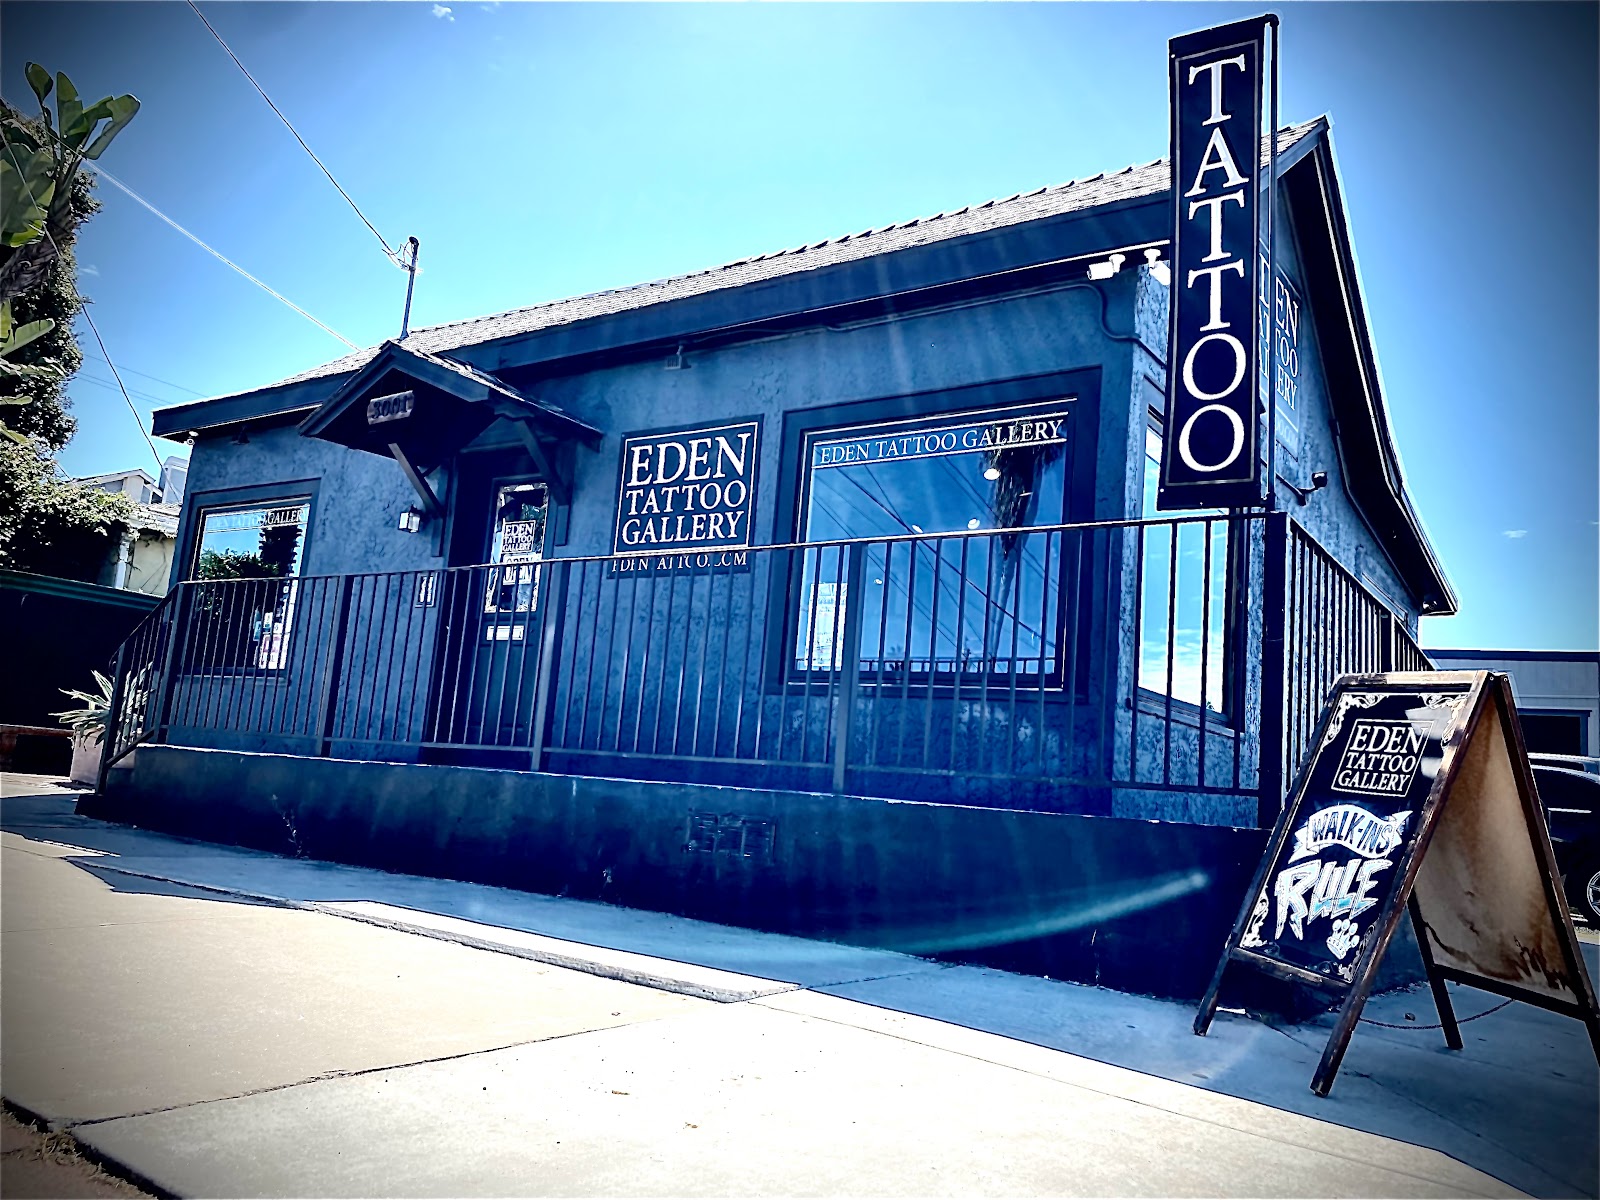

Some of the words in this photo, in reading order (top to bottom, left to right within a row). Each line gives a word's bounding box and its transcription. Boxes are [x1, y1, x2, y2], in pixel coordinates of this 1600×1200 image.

[1179, 54, 1249, 473] TATTOO
[820, 442, 871, 465] EDEN
[875, 432, 956, 460] TATTOO
[962, 418, 1064, 449] GALLERY
[626, 433, 751, 487] EDEN
[625, 480, 747, 516] TATTOO
[504, 534, 533, 545] TATTOO
[505, 523, 534, 537] EDEN
[621, 510, 745, 545] GALLERY
[1350, 725, 1428, 754] EDEN
[1345, 751, 1416, 773] TATTOO
[1337, 769, 1410, 792] GALLERY
[1311, 810, 1393, 855] WALK-INS
[1274, 858, 1393, 941] RULE
